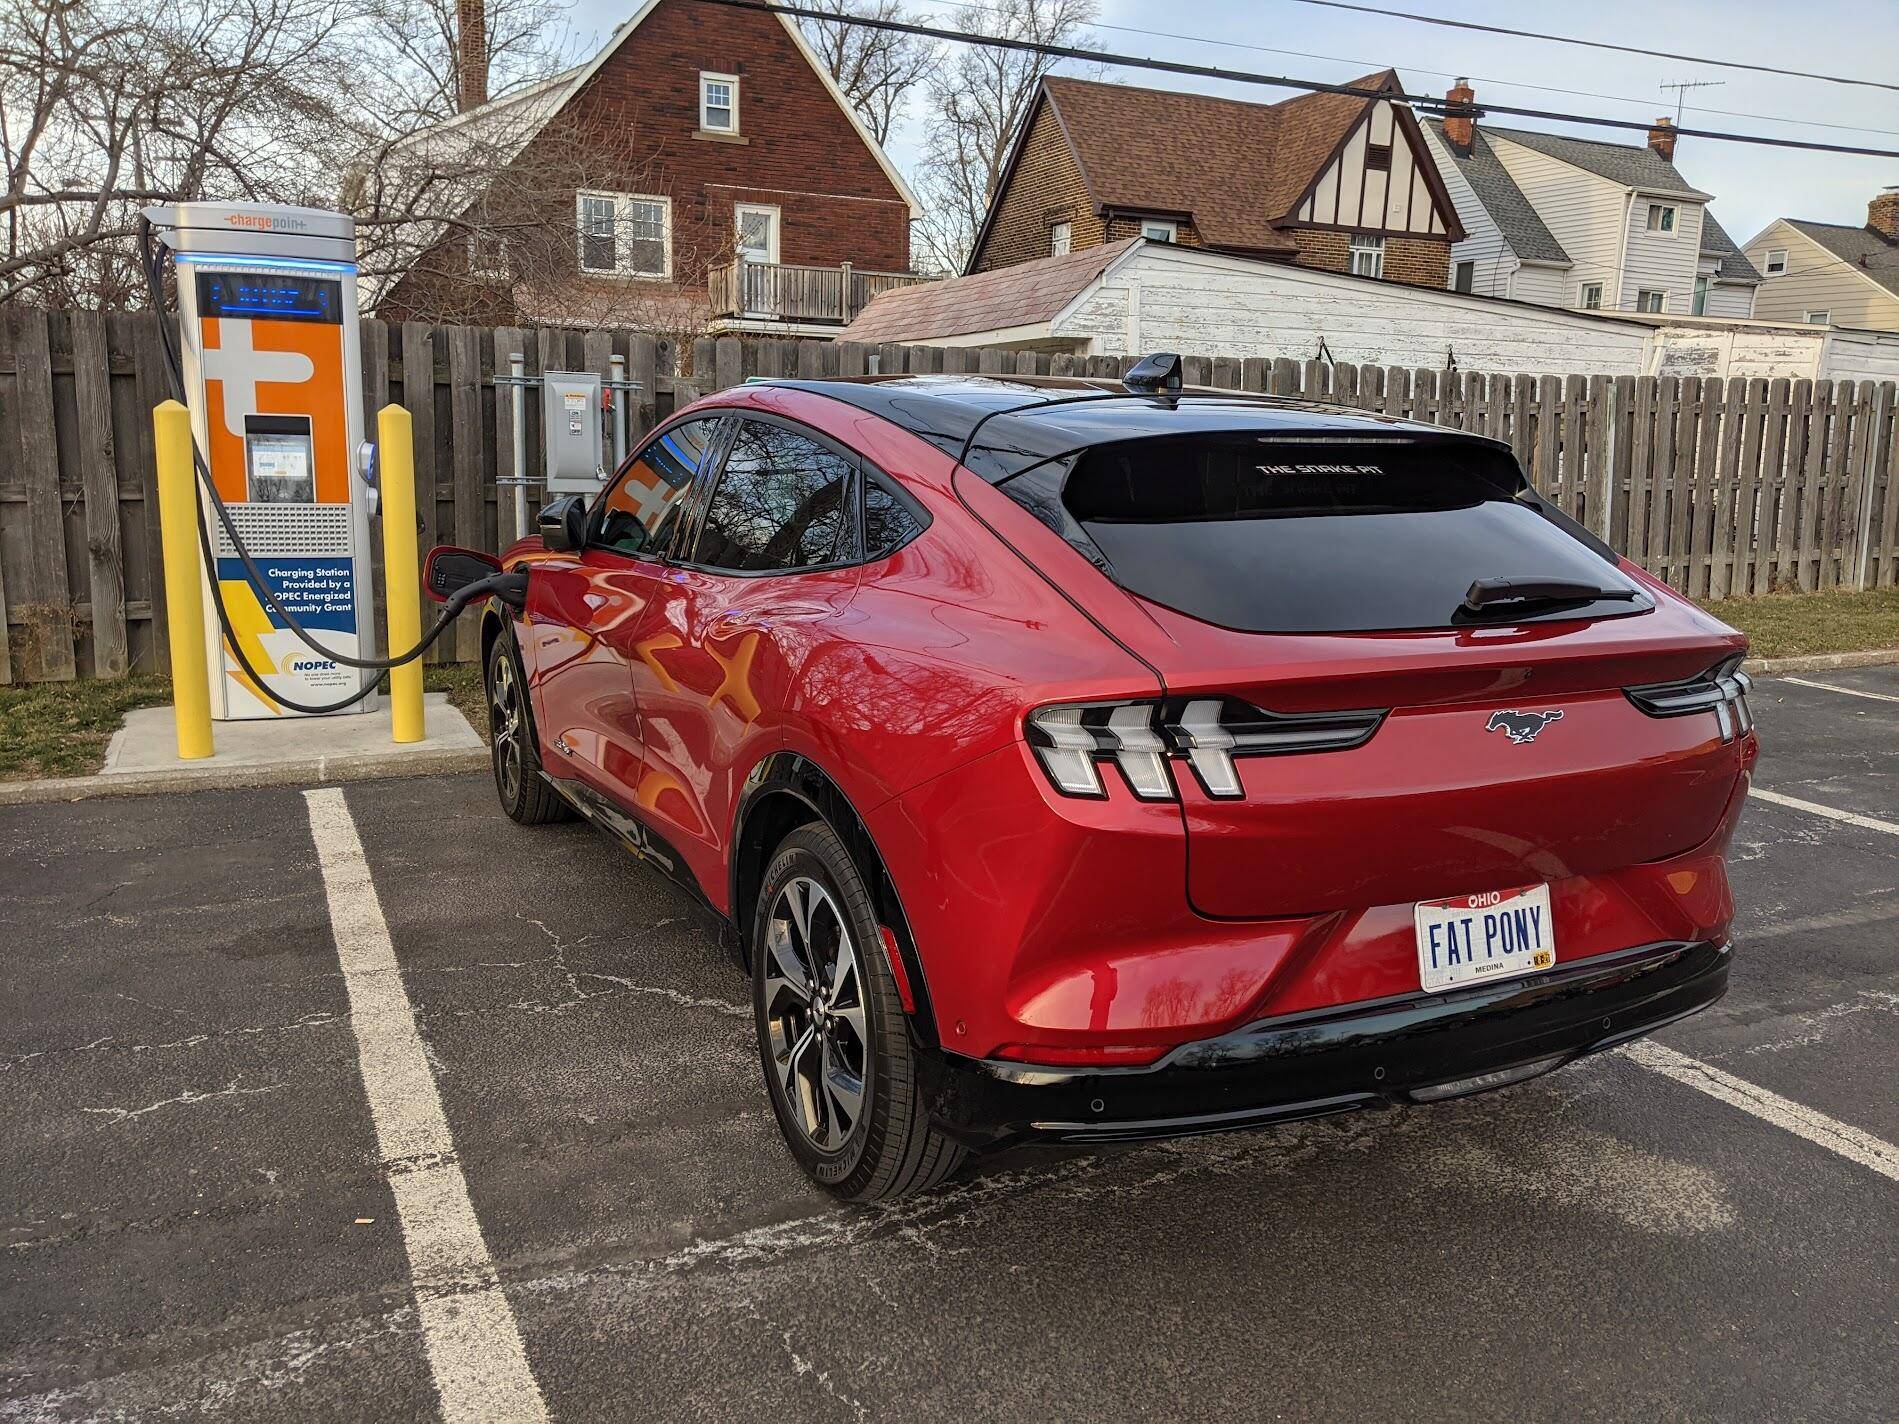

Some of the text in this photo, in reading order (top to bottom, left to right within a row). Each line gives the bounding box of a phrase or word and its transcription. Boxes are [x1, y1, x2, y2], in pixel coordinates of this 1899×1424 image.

[1256, 465, 1383, 474] THE SNAKE PIT
[268, 568, 350, 579] Charging Station
[282, 580, 327, 589] Provided
[329, 580, 341, 590] by
[266, 591, 351, 601] OPEC Energized
[324, 603, 352, 612] Grant
[293, 661, 337, 671] NOPEC
[1468, 891, 1500, 908] OHIO
[1428, 905, 1541, 969] FAT PONY
[1475, 962, 1505, 974] MEDINA
